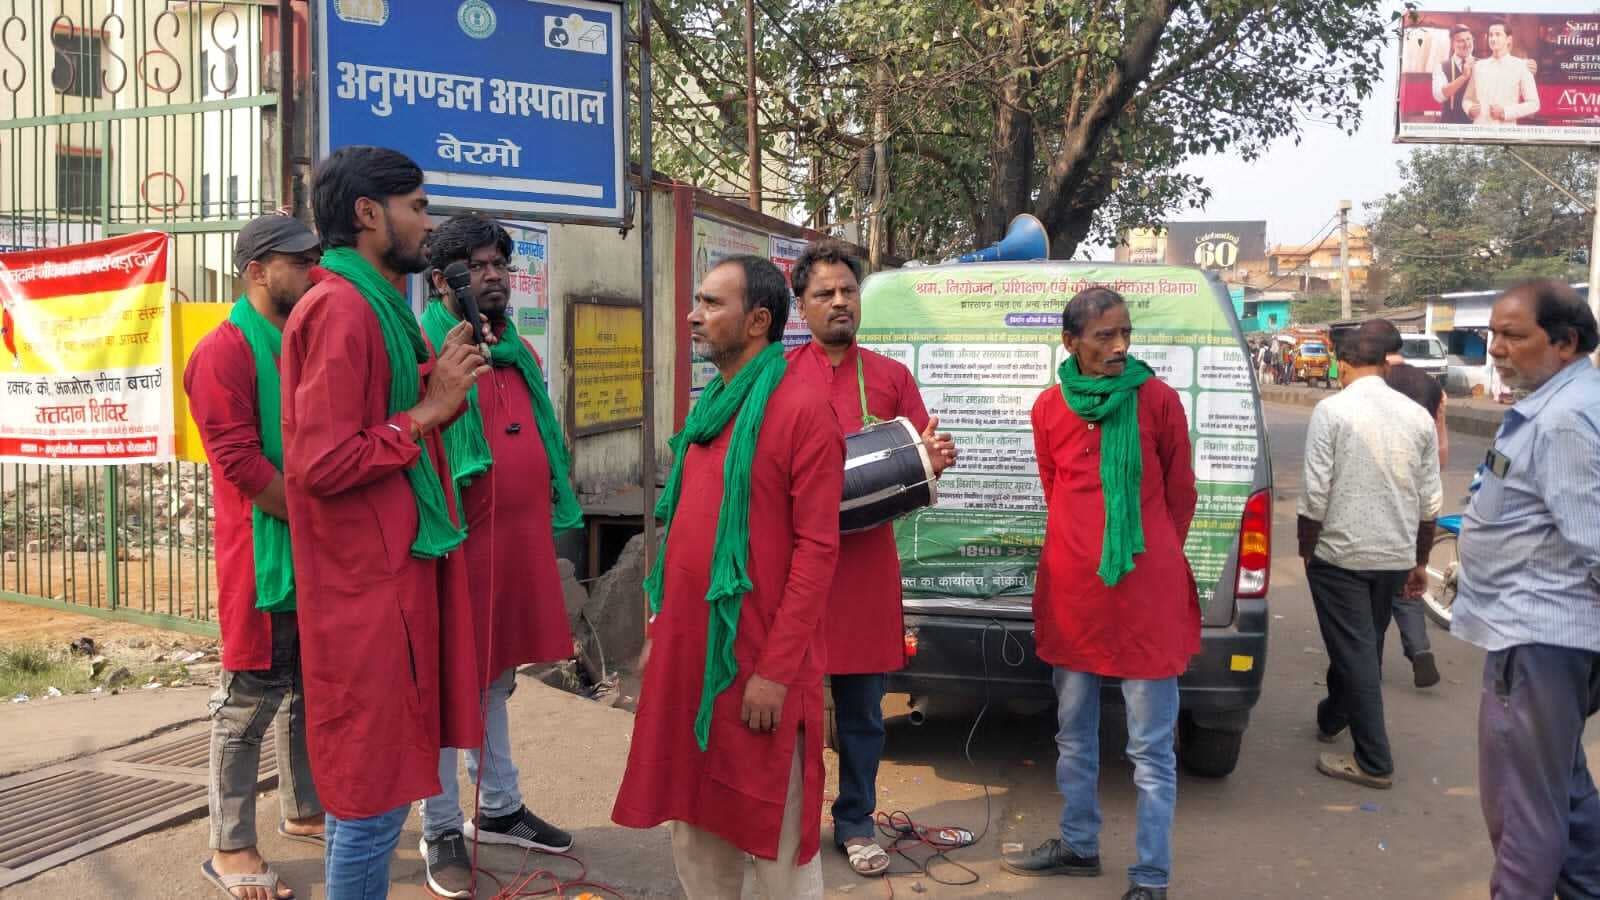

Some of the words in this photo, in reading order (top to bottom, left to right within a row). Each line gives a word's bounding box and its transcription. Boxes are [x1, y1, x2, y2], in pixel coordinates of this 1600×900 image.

[1557, 34, 1594, 48] Fitting
[1573, 54, 1590, 62] GET
[336, 61, 484, 117] अनुमण्डल
[489, 79, 607, 125] अस्पताल
[436, 132, 522, 168] बेरमो
[1195, 231, 1240, 244] Celebrating
[1194, 241, 1240, 267] 60
[917, 281, 941, 294] श्रम,
[946, 279, 997, 295] नियोजन,
[1002, 279, 1047, 294] प्रशिक्षण
[1159, 279, 1198, 294] विभाग
[54, 376, 93, 395] अनमोल
[88, 398, 129, 423] शिविर
[959, 545, 1002, 557] 1800
[920, 576, 934, 587] का
[938, 571, 988, 587] कार्यालय,
[992, 573, 1028, 587] बोकारो
